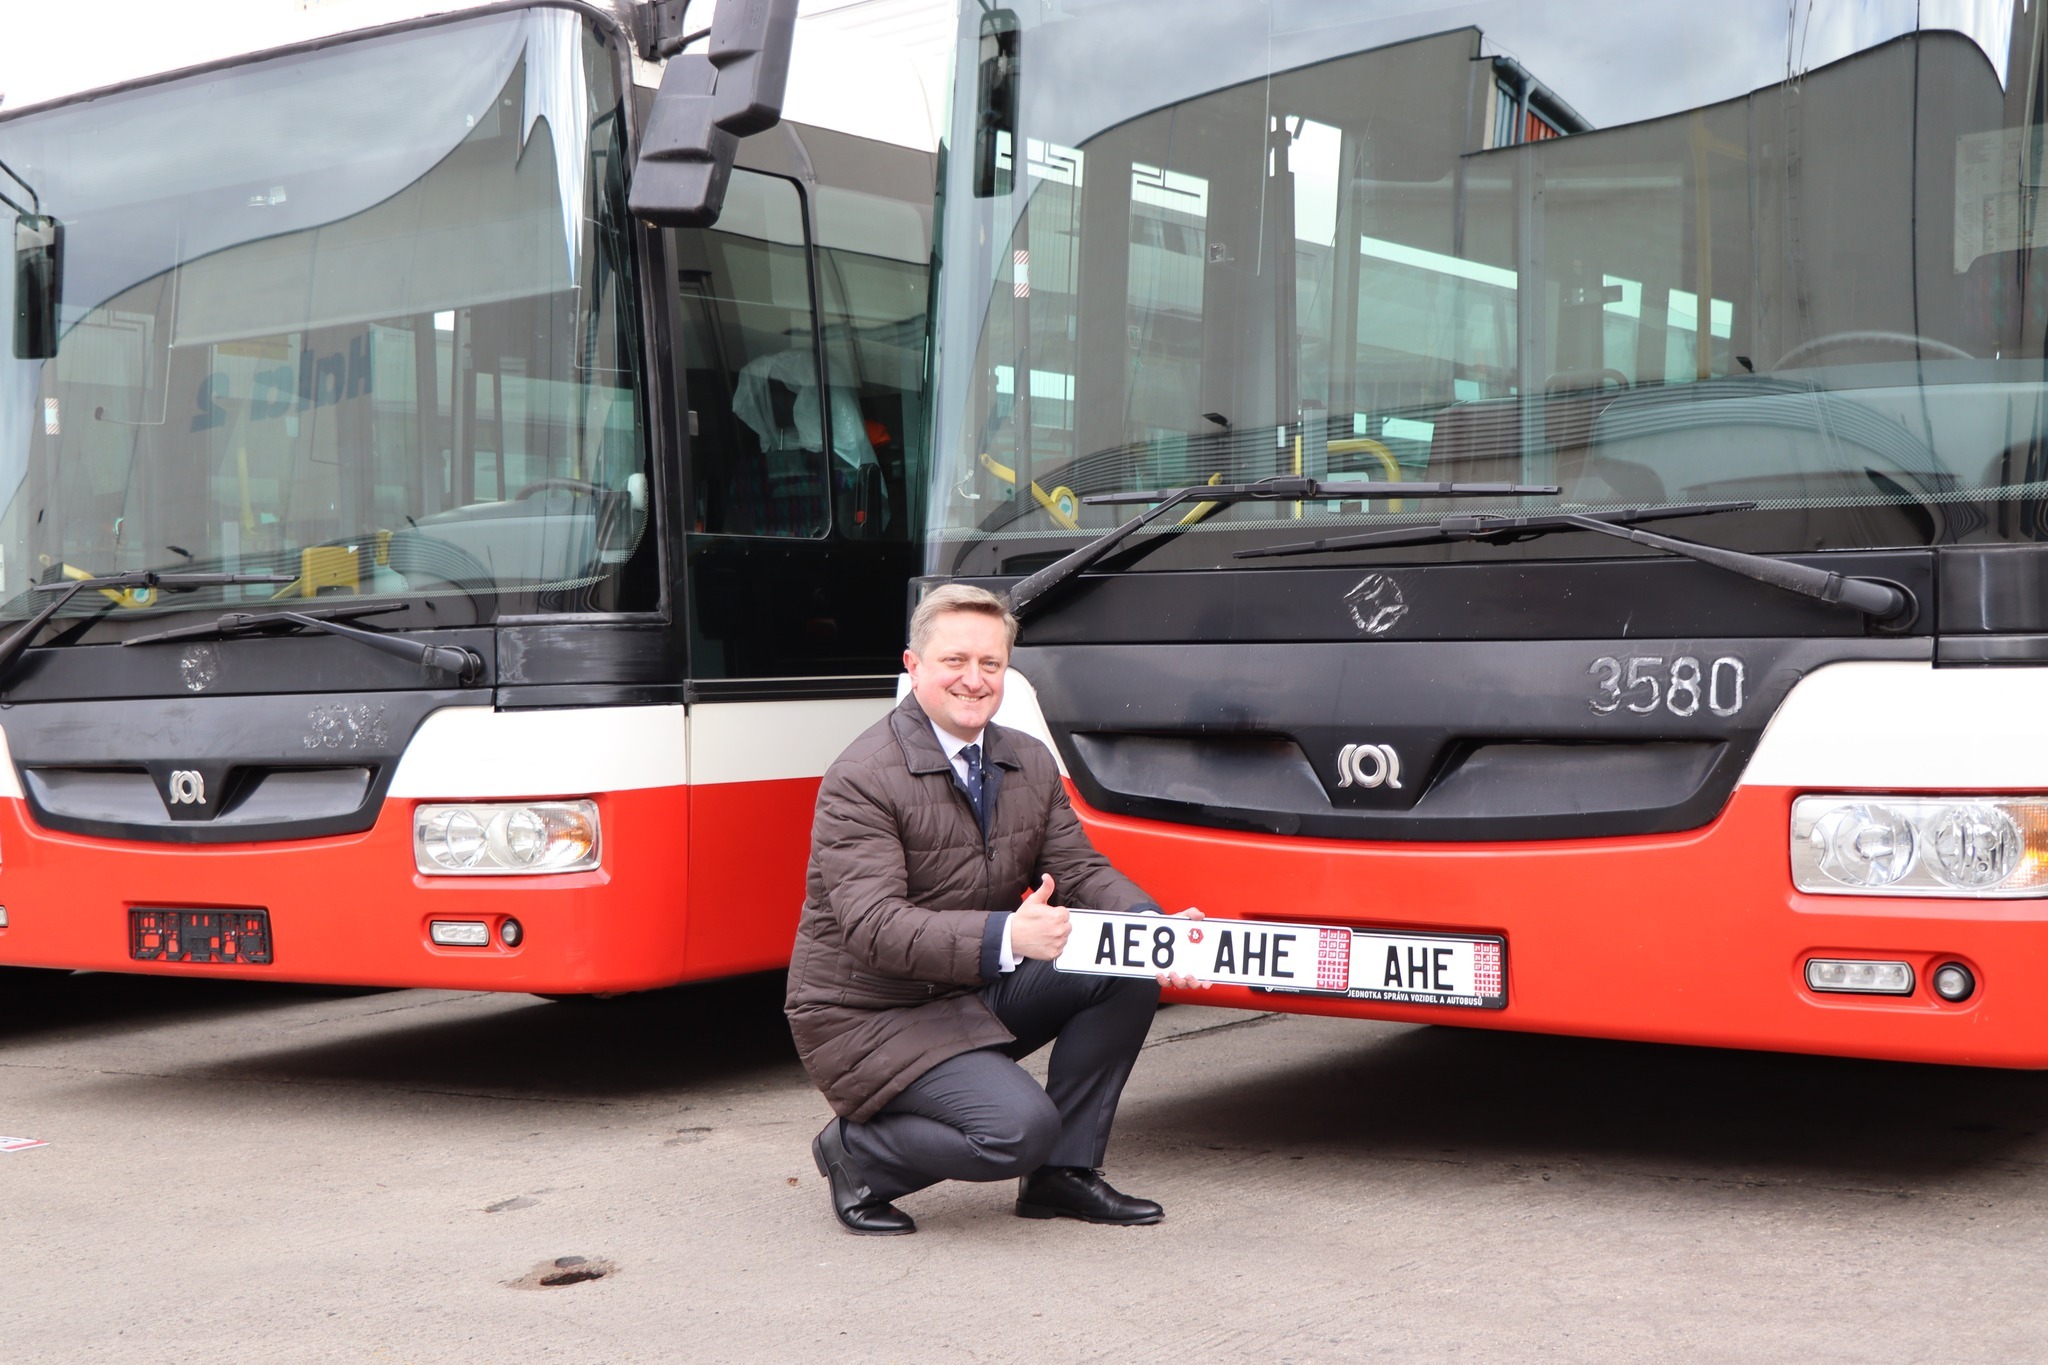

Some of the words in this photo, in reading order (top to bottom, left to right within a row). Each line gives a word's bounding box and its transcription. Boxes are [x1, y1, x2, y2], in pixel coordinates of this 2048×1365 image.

[1587, 656, 1745, 717] 3580
[1094, 921, 1176, 969] AE8
[1213, 929, 1297, 979] AHE
[1384, 945, 1454, 991] AHE
[1347, 989, 1382, 999] JEDNOTKA
[1383, 990, 1409, 1002] SPRÁVA
[1410, 993, 1438, 1004] VOZIDEL
[1439, 995, 1445, 1004] A
[1446, 995, 1483, 1006] AUTOBUSŮ
